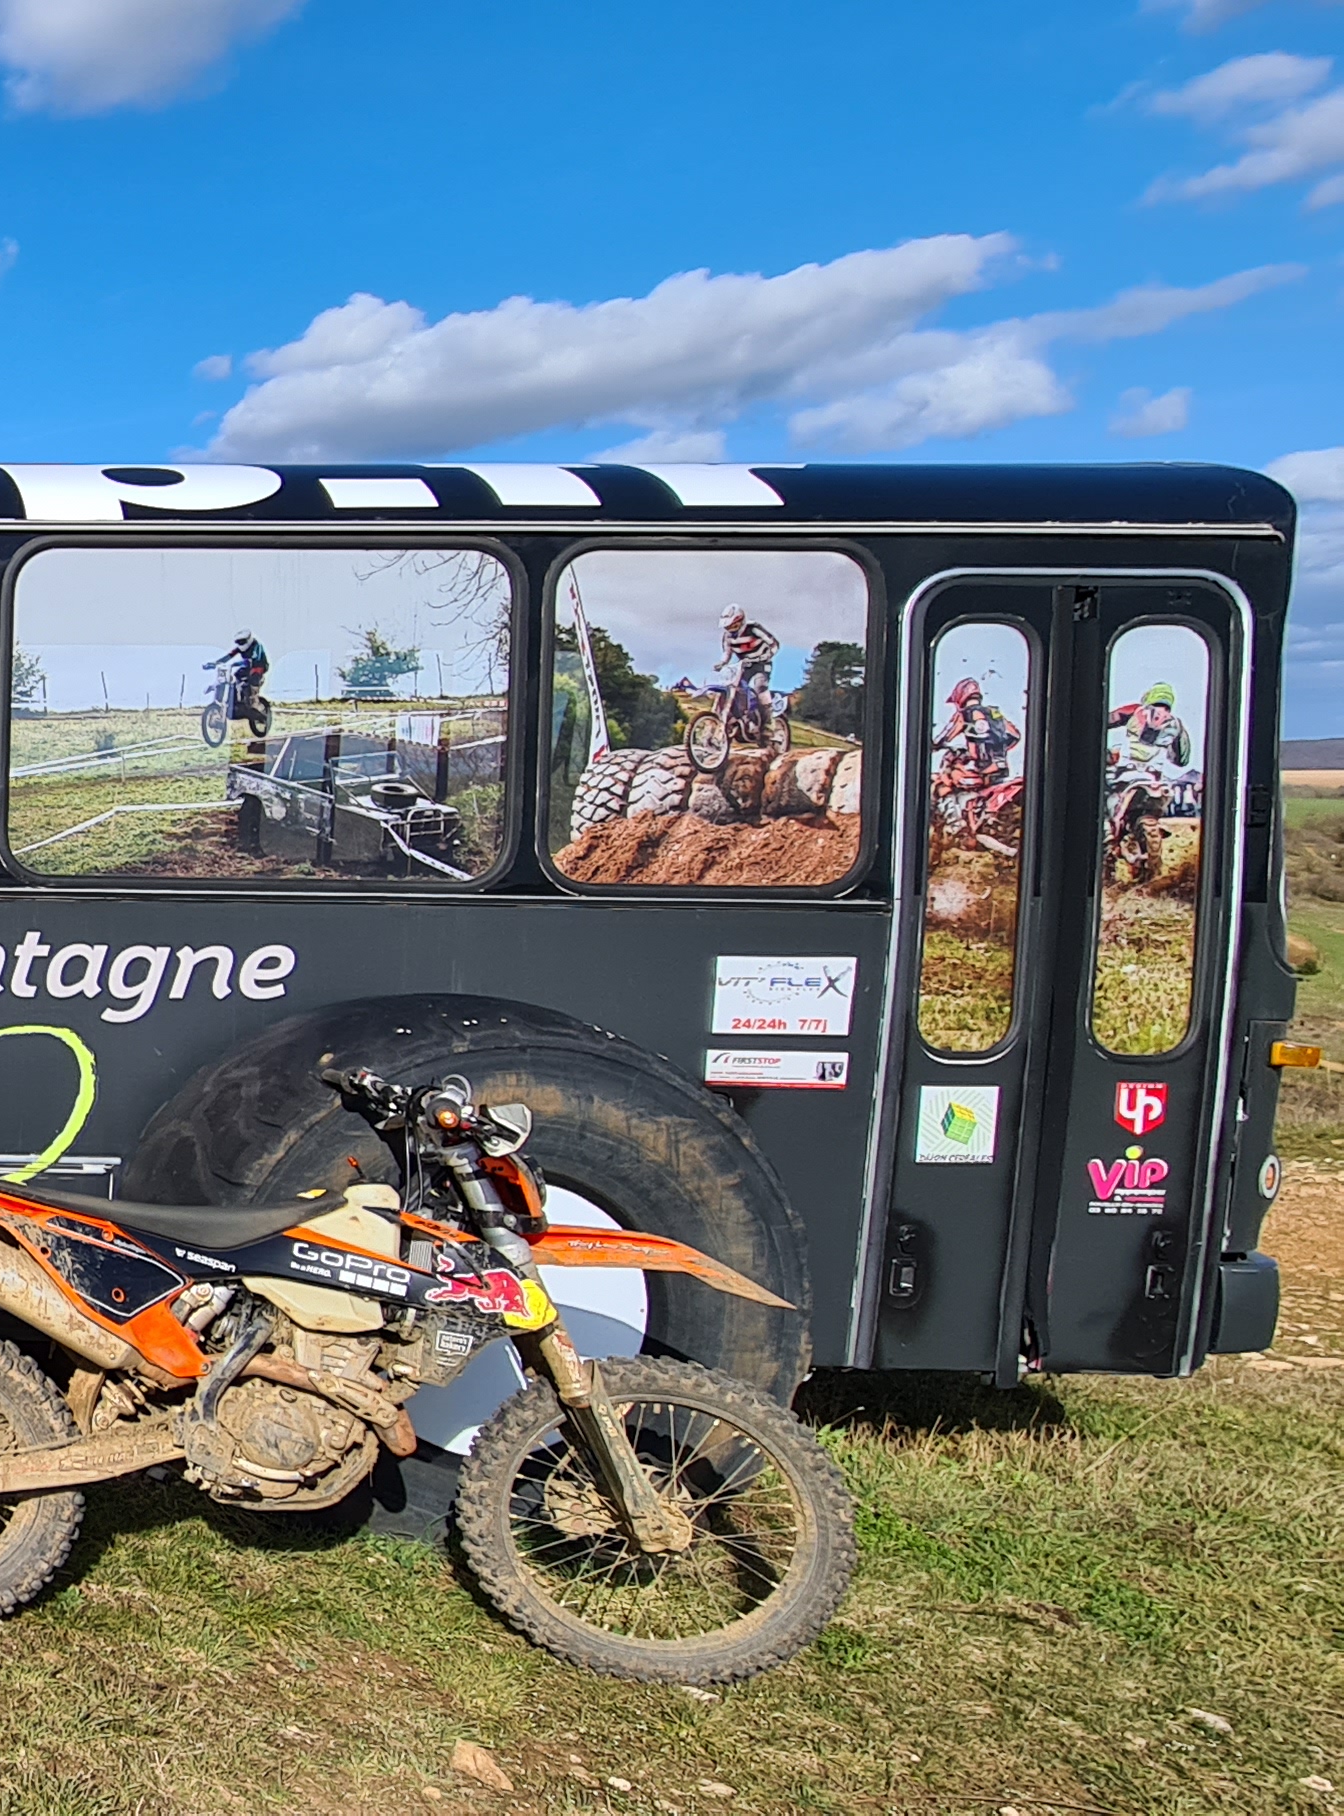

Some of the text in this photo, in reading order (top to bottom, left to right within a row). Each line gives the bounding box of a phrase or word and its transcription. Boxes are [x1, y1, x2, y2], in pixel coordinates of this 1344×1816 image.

[731, 1018, 829, 1034] 24/24h 7/7j
[186, 1250, 237, 1273] seaspan
[292, 1241, 411, 1284] GoPro
